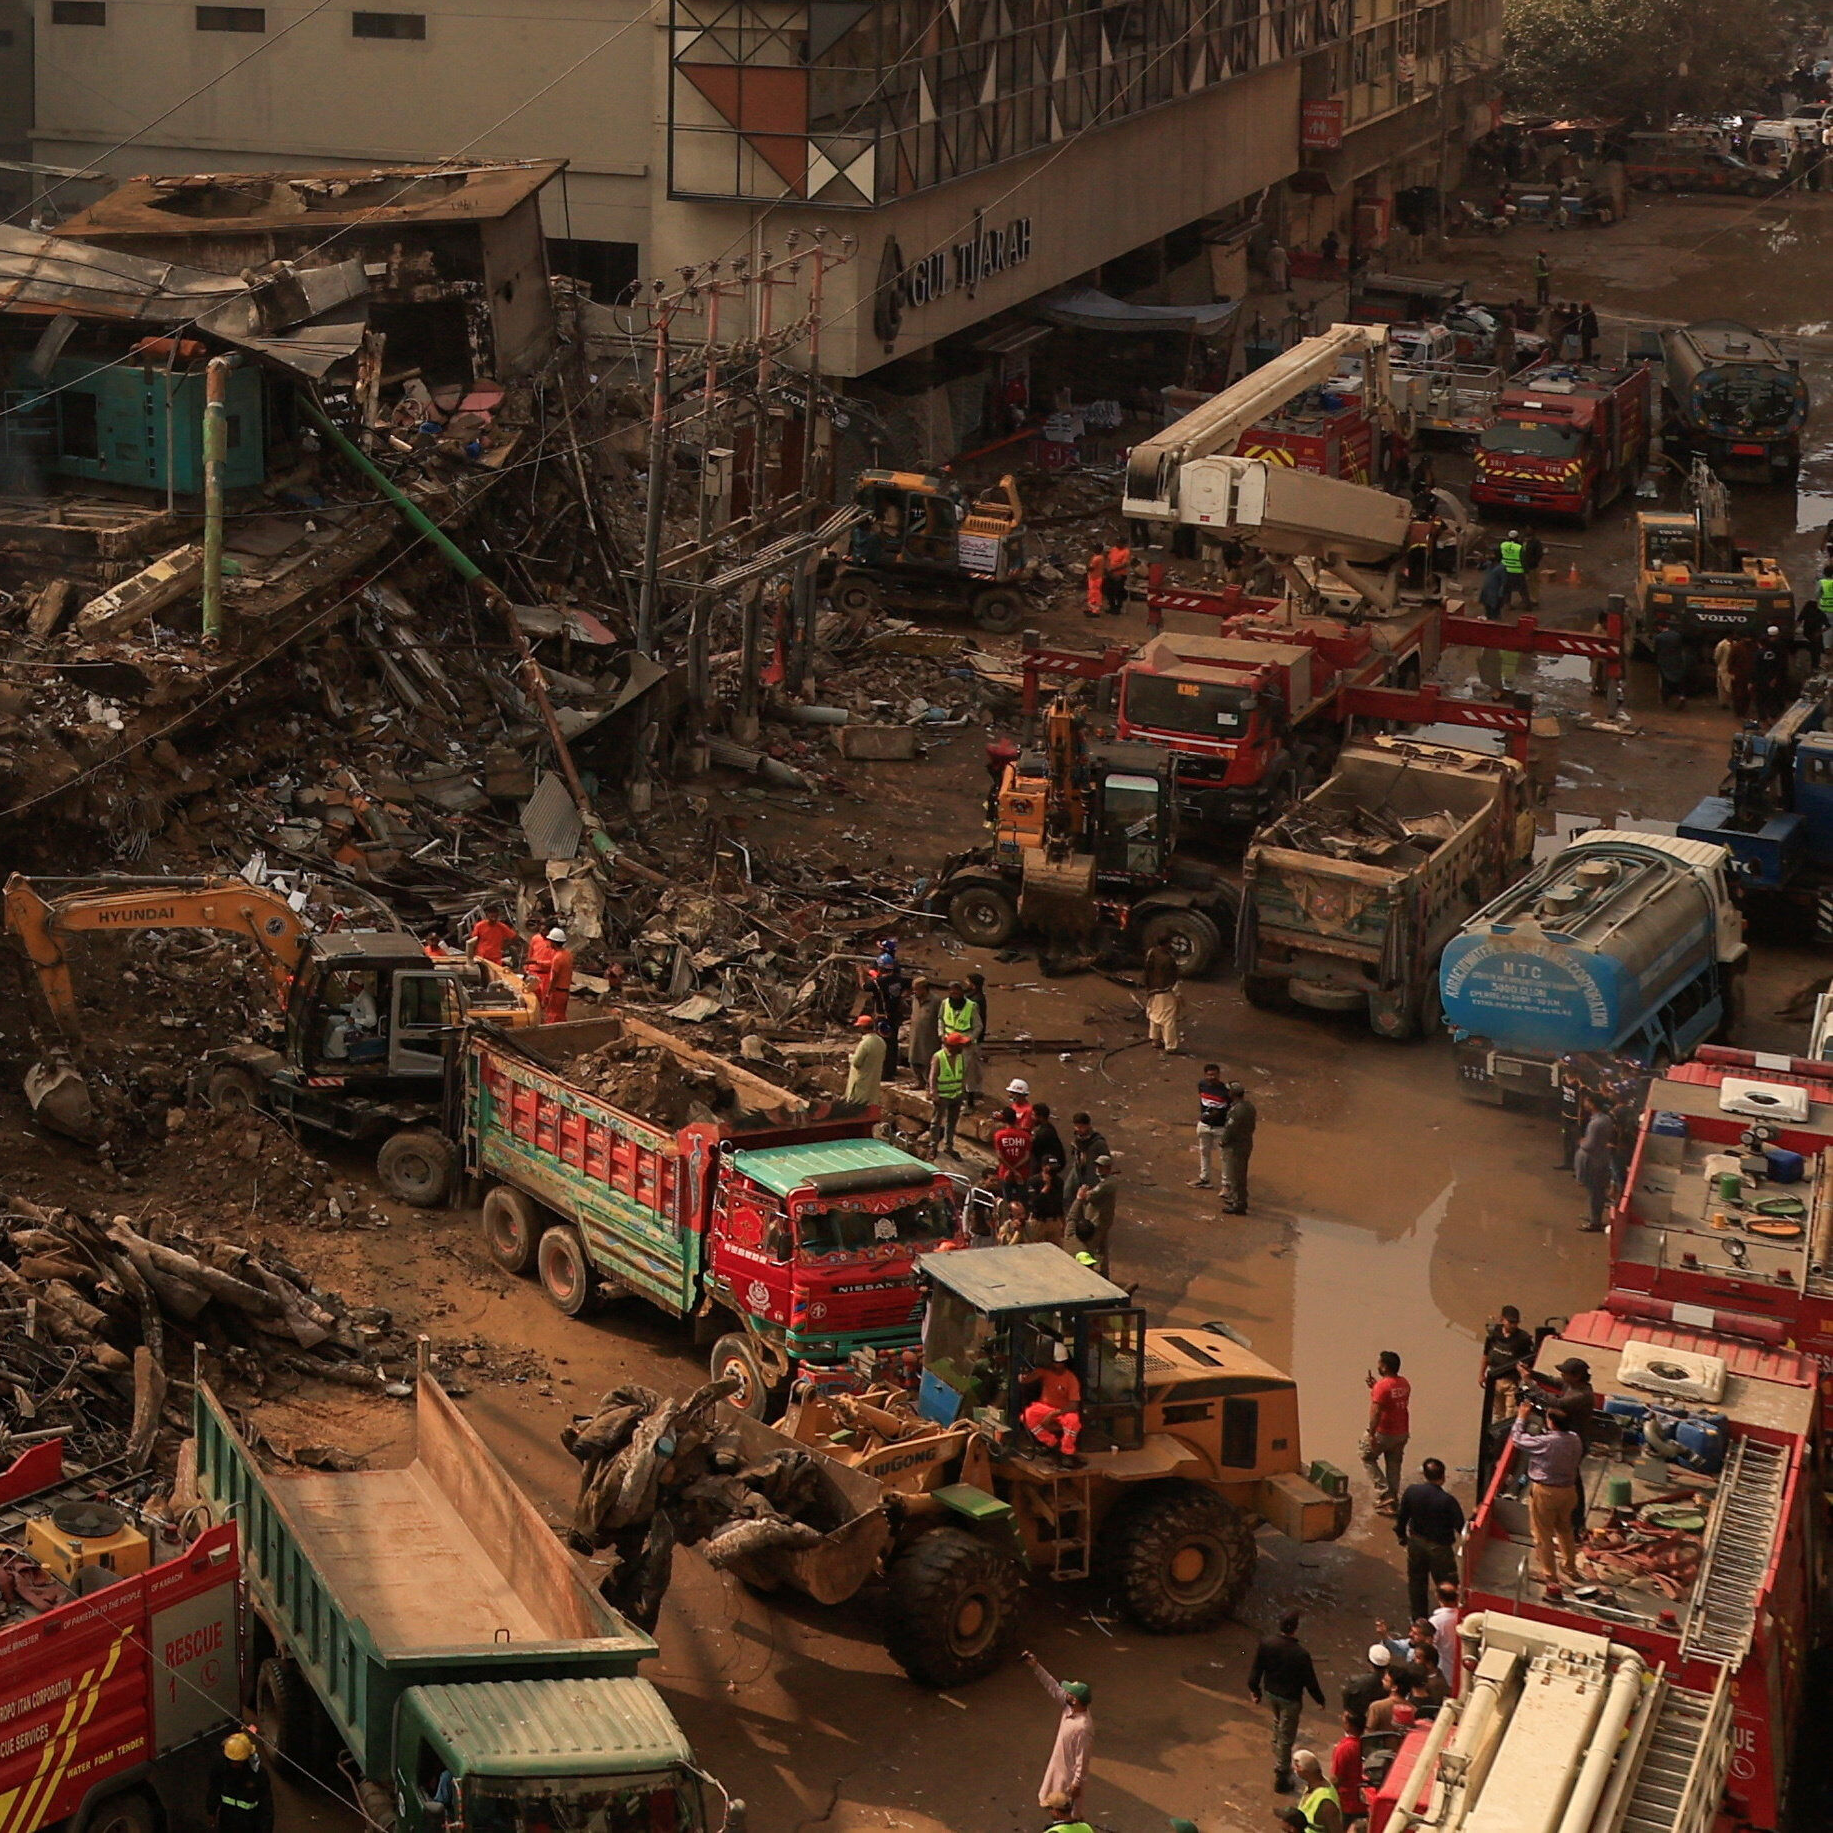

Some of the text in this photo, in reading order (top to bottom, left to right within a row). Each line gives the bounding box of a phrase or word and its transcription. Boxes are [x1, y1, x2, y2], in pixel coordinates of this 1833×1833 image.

[912, 251, 950, 307] GUL
[1696, 613, 1748, 623] VOLVO
[99, 907, 175, 923] HYUNDAI
[1001, 1137, 1025, 1147] EDHI
[838, 1281, 895, 1293] NISSAN
[165, 1620, 223, 1670] RESCUE
[32, 1677, 72, 1709] CORPORATION
[15, 1722, 49, 1751] SERVICES
[66, 1736, 145, 1779] WATER FOAM TENDER
